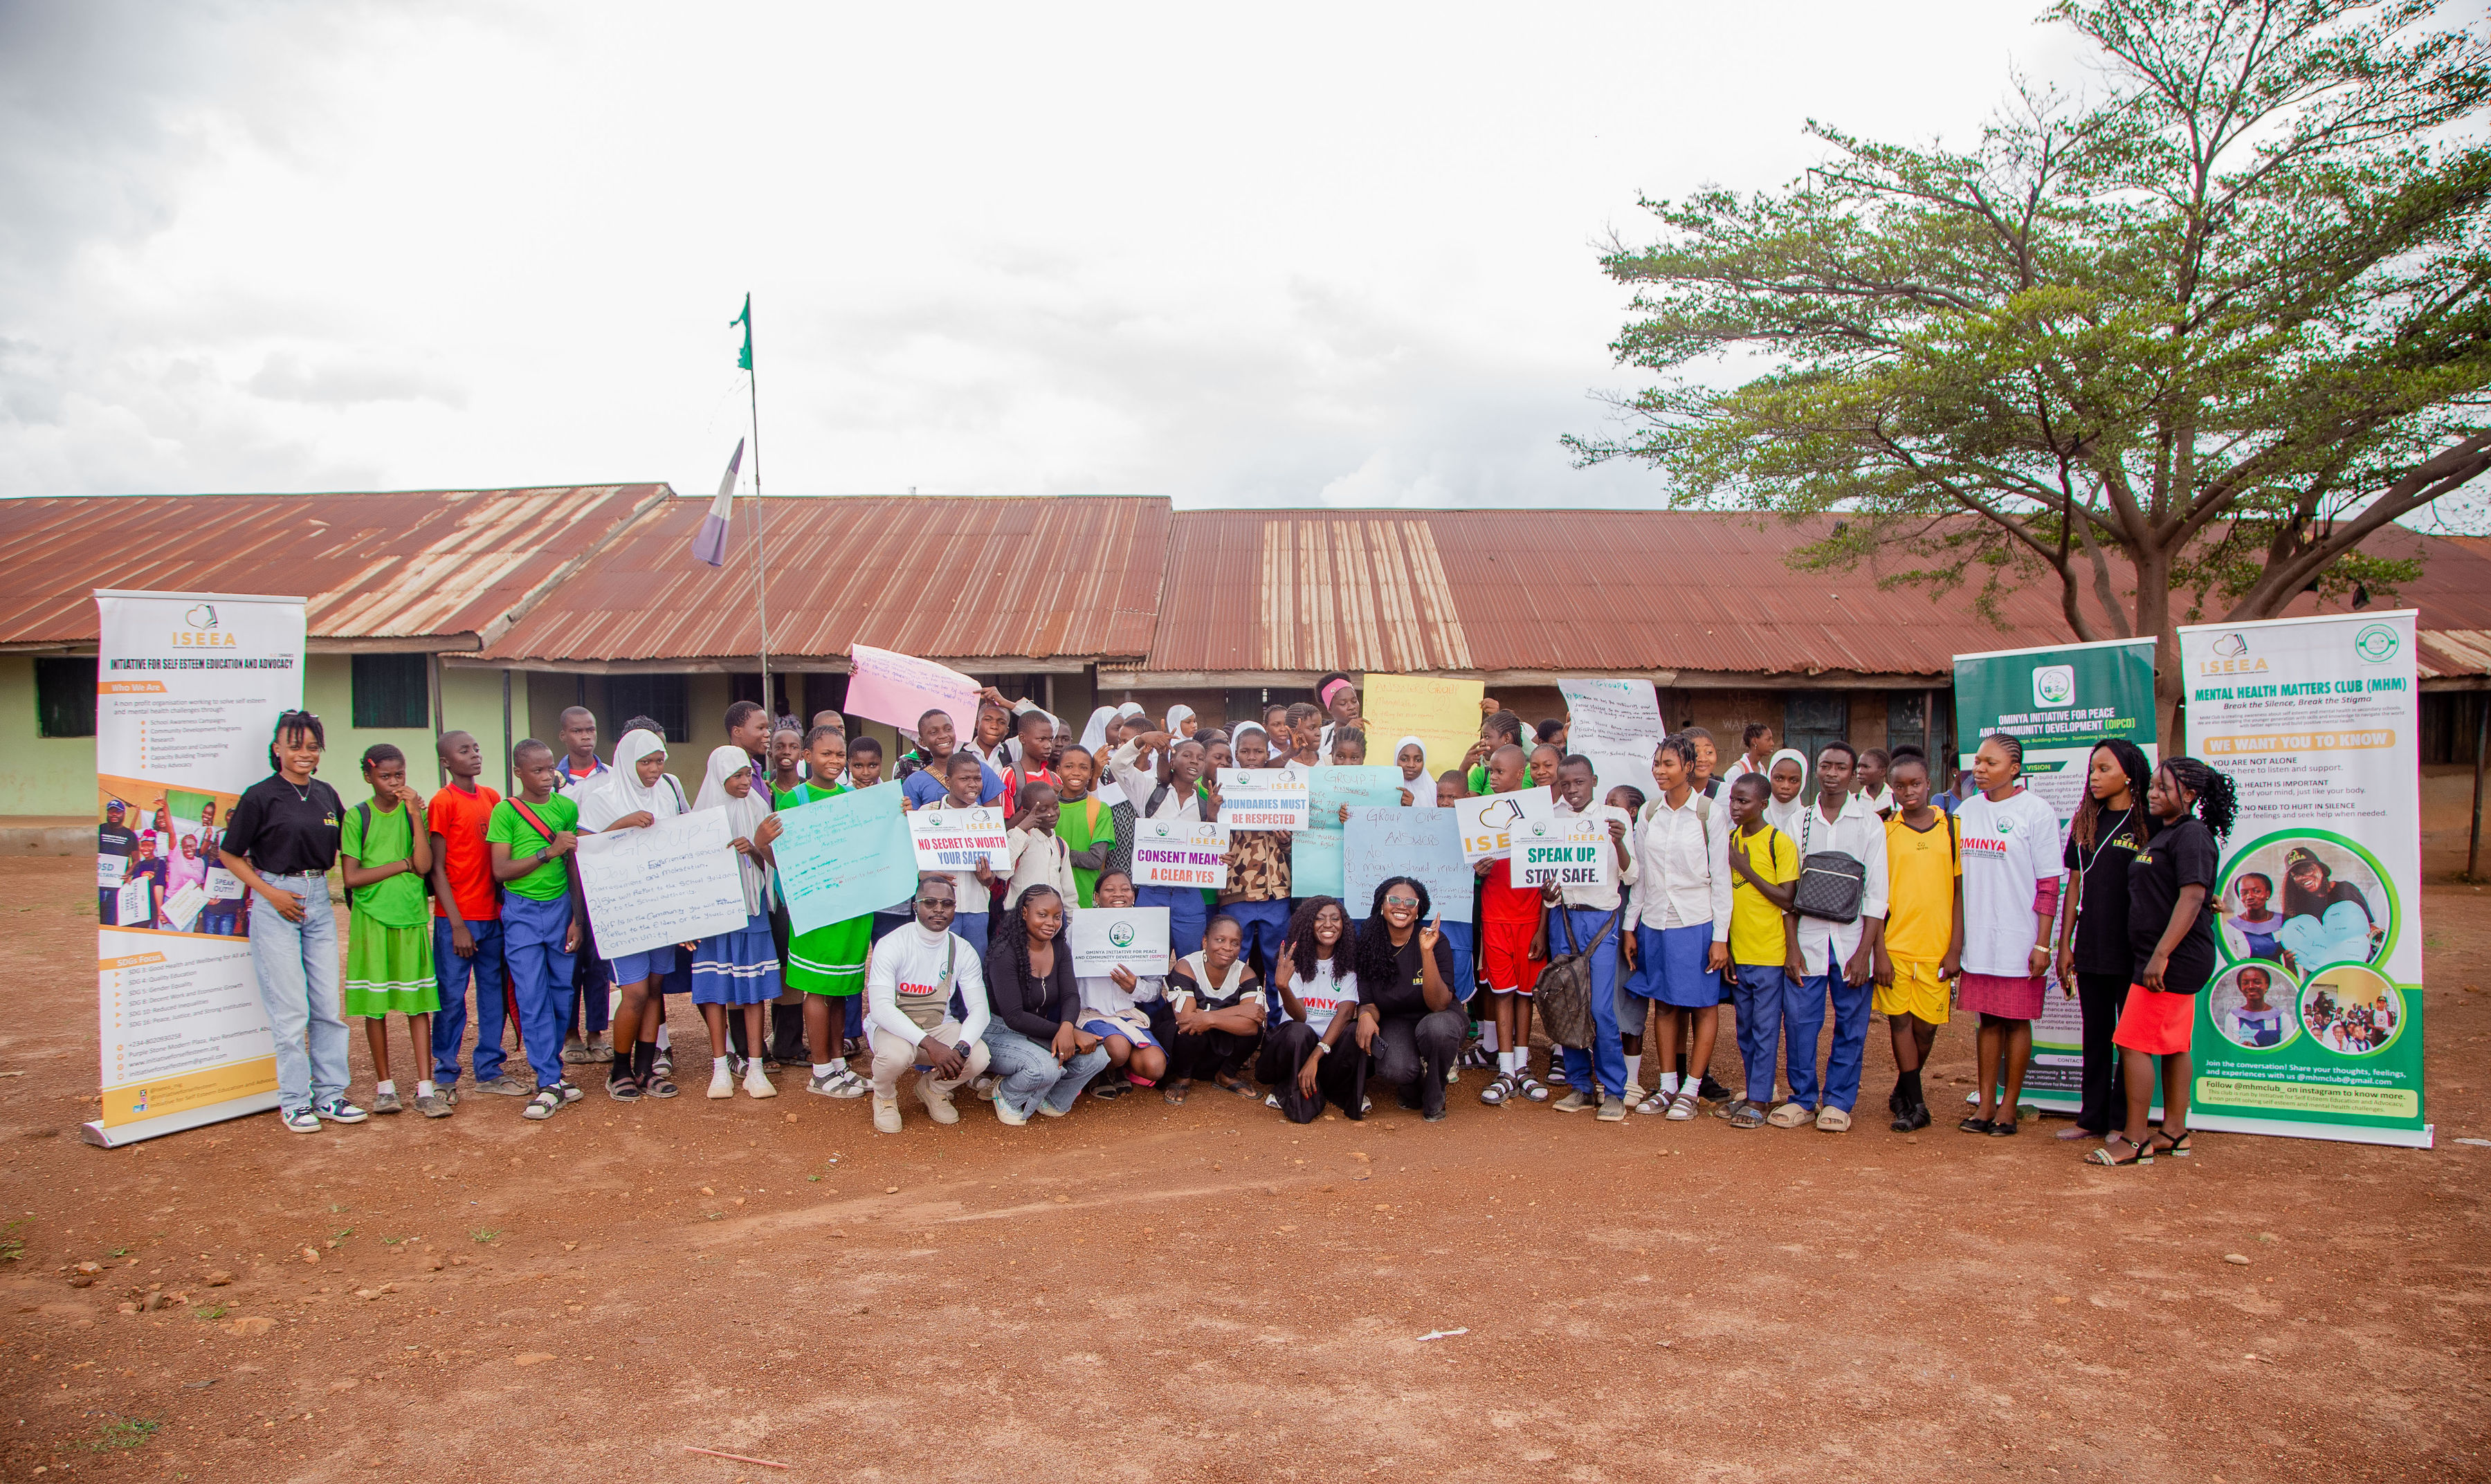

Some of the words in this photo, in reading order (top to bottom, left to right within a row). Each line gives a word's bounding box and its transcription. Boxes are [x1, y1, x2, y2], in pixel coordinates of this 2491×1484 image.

[172, 632, 237, 645] ISEEA
[111, 659, 147, 670] INITIATIVE
[148, 659, 162, 670] FOR
[163, 659, 179, 669] SELF
[179, 659, 206, 669] ESTEEM
[206, 659, 243, 669] EDUCATION
[244, 659, 257, 669] AND
[259, 659, 293, 669] ADVOCACY
[2200, 658, 2269, 673] ISEEA
[2195, 688, 2234, 702] MENTAL
[2237, 685, 2277, 699] HEALTH
[2281, 681, 2331, 696] MATTERS
[2335, 680, 2363, 693] CLUB
[2366, 677, 2407, 693] (MHM)
[2224, 702, 2247, 710] Break
[2265, 699, 2295, 708] Silence,
[2342, 696, 2372, 704] Stigma
[1998, 714, 2029, 725] OMINYA
[2029, 711, 2070, 723] INITIATIVE
[2071, 709, 2087, 720] FOR
[2088, 707, 2115, 720] PEACE
[1979, 727, 1994, 738] AND
[1996, 724, 2044, 735] COMMUNITY
[2045, 720, 2103, 733] DEVELOPMENT
[2209, 740, 2231, 752] WE
[2234, 738, 2276, 751] WANT
[2281, 735, 2310, 749] YOU
[2315, 735, 2335, 747] TO
[2339, 733, 2387, 746] KNOW
[1221, 799, 1278, 809] BOUNDARIES
[1280, 799, 1306, 809] MUST
[1232, 814, 1243, 823] BE
[1246, 814, 1295, 825] RESPECTED
[918, 839, 930, 850] NO
[931, 838, 963, 850] SECRET
[965, 837, 974, 848] IS
[974, 836, 1007, 848] WORTH
[1191, 837, 1225, 845] ISEEA
[1465, 832, 1511, 852] ISE
[938, 852, 961, 864] YOUR
[1138, 849, 1186, 863] CONSENT
[1528, 848, 1573, 863] SPEAK
[1577, 847, 1596, 863] UP,
[1151, 868, 1158, 880] A
[1160, 868, 1193, 882] CLEAR
[1196, 870, 1214, 883] YES
[1526, 868, 1558, 884] STAY
[1562, 868, 1598, 883] SAFE.
[117, 958, 138, 967] SDGs
[2236, 1062, 2287, 1070] conversation!
[2333, 1067, 2371, 1076] thoughts,
[2373, 1069, 2407, 1078] feelings,
[2222, 1070, 2265, 1078] experiences
[2297, 1074, 2392, 1085] @mhmclub@gmail.com
[2300, 1087, 2341, 1096] instagram
